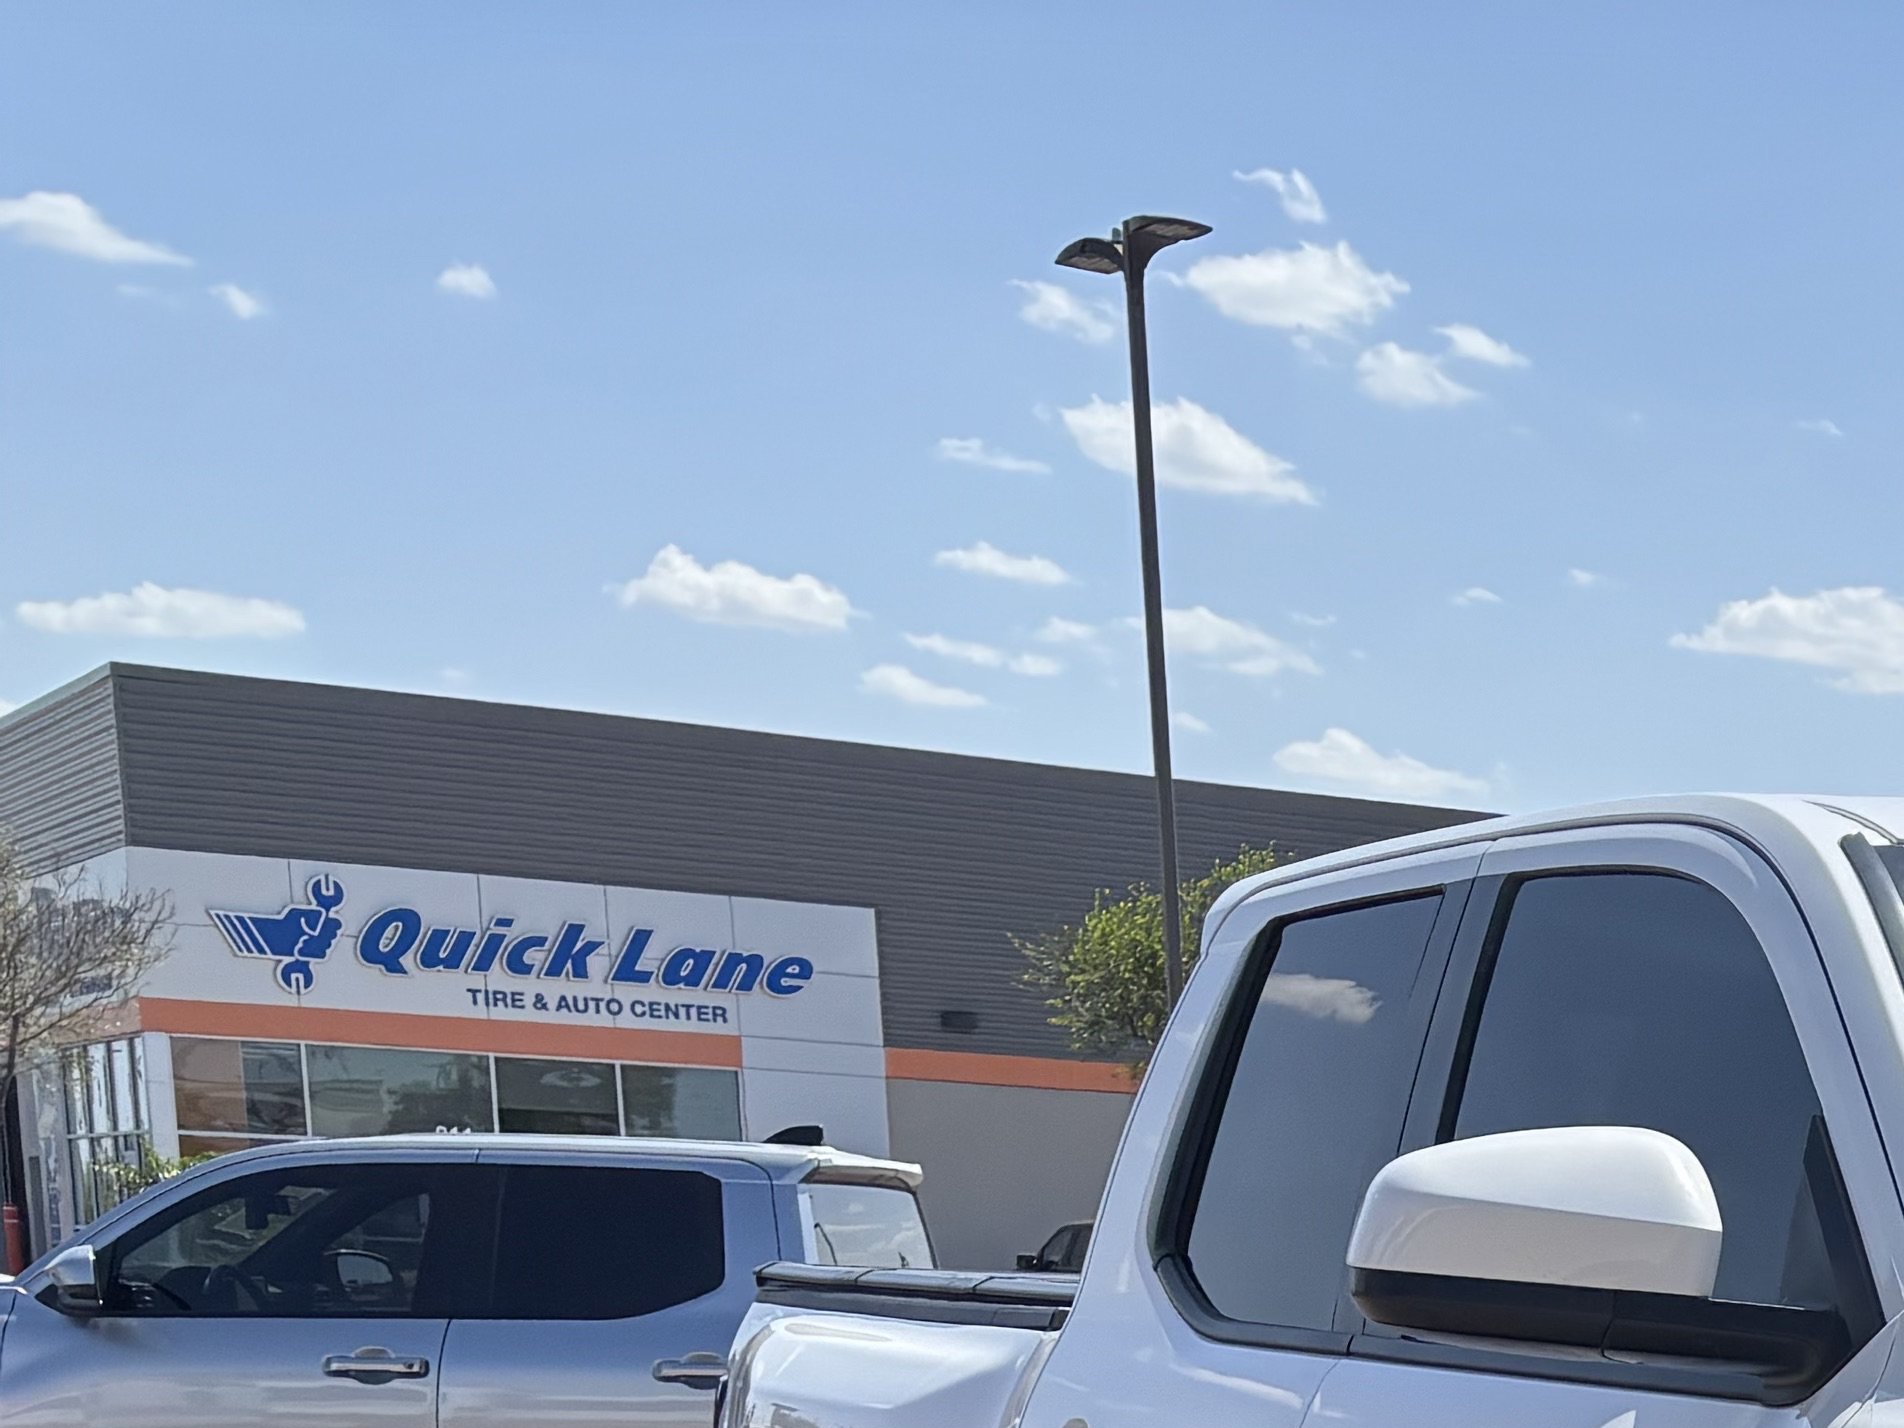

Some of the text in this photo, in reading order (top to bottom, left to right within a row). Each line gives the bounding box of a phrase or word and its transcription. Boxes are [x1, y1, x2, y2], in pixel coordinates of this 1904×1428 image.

[357, 907, 815, 997] Quick Lane
[467, 987, 729, 1024] TIRE & AUTO CENTER
